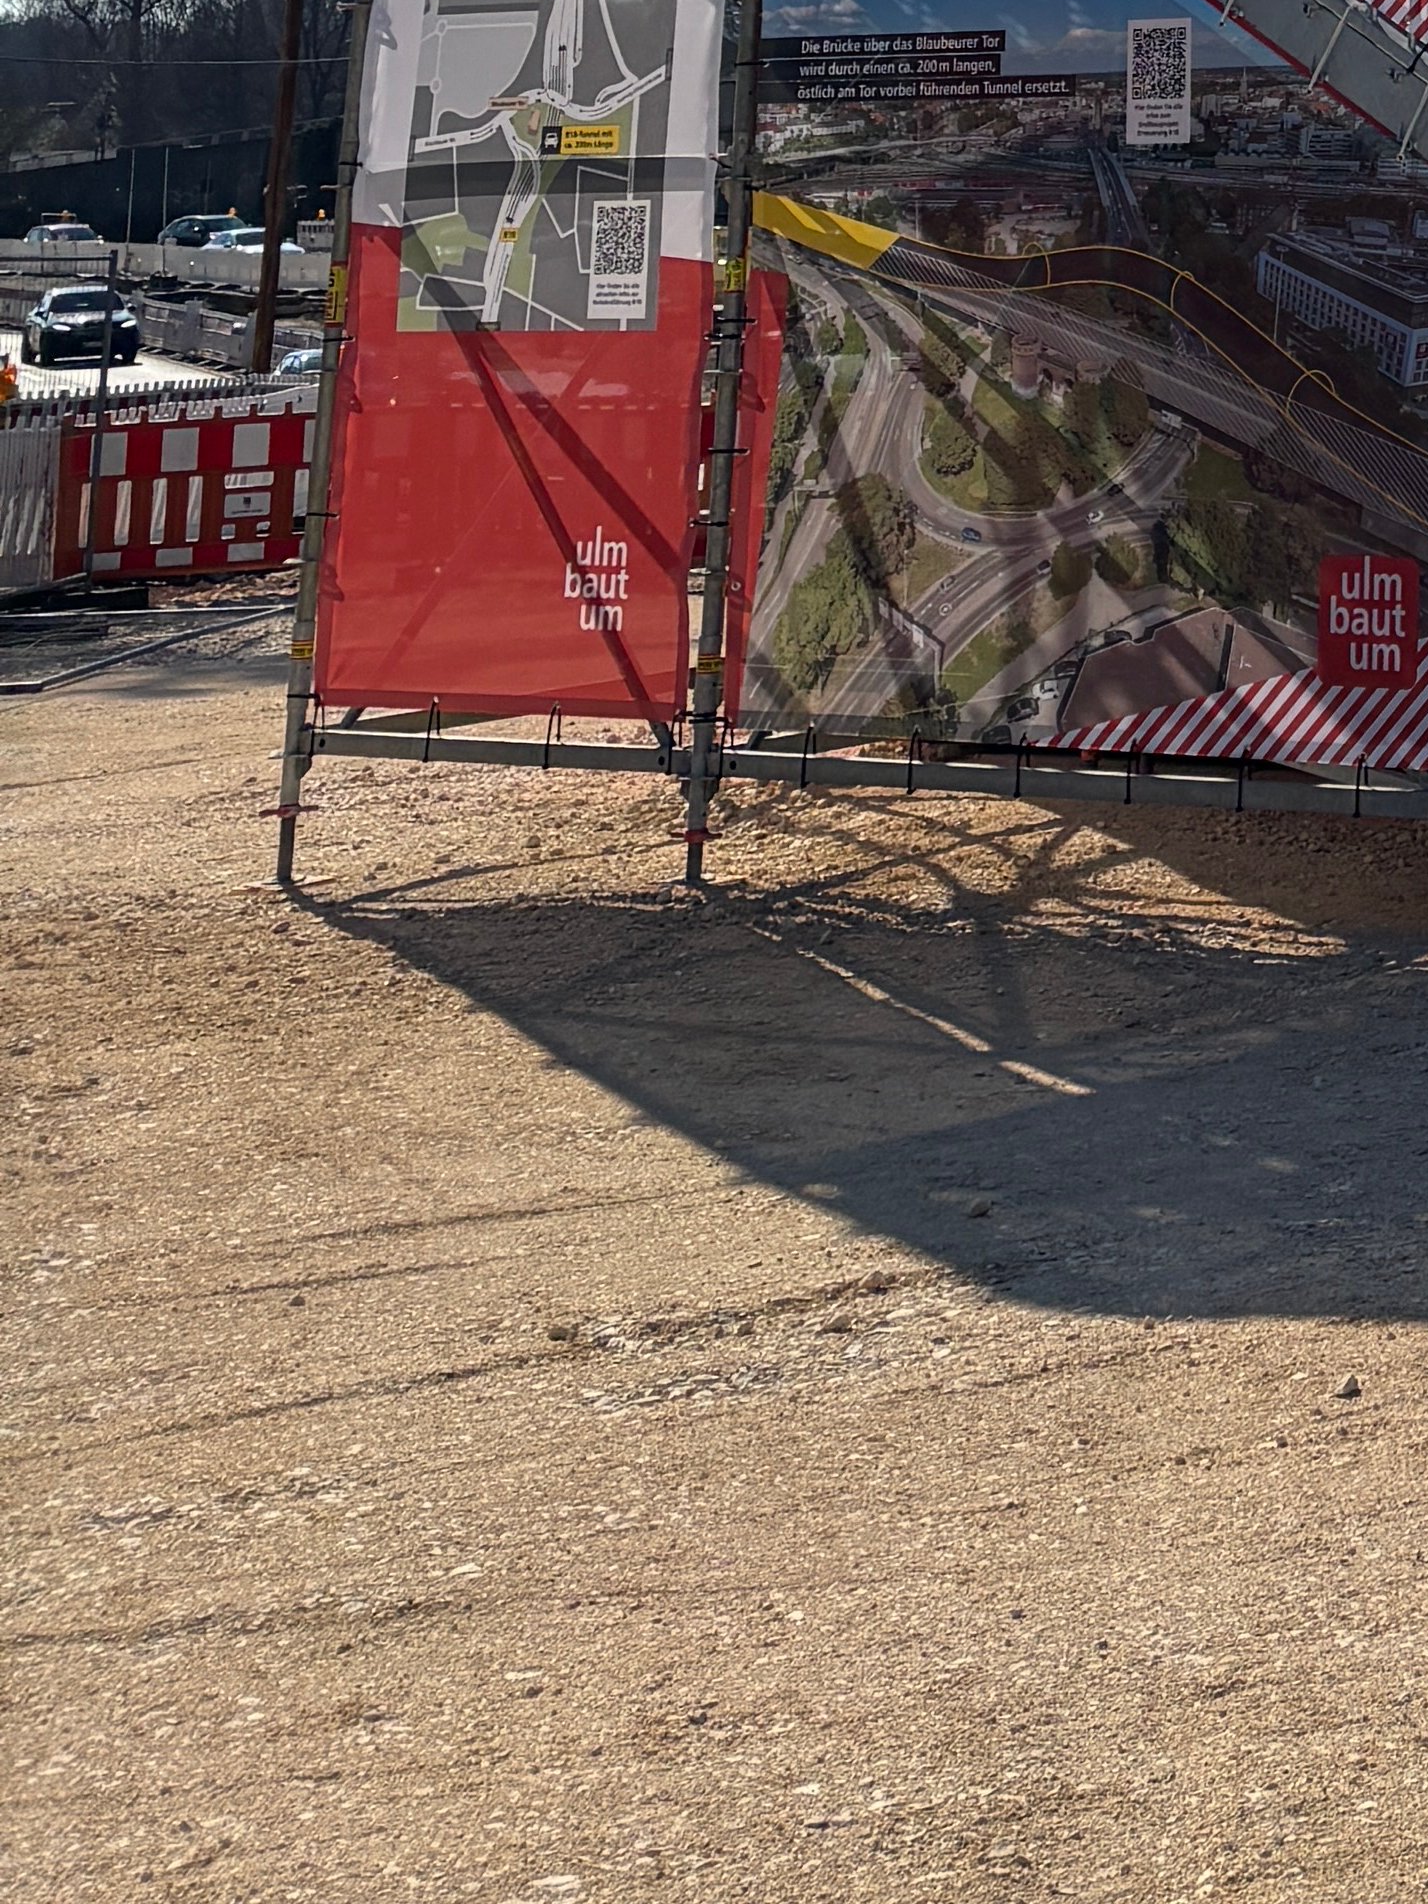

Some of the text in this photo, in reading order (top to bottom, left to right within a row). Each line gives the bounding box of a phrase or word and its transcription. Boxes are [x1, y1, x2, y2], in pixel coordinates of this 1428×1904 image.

[801, 35, 1000, 54] Die Brücke über das Blaubeurer Tor
[799, 61, 826, 77] wird
[828, 60, 861, 76] durch
[863, 60, 895, 75] einen
[898, 62, 914, 75] ca.
[953, 58, 996, 75] langen,
[797, 79, 1070, 100] östlich am Tor vorbei führenden Tunnel ersetzt.
[576, 525, 628, 568] ulm
[563, 562, 630, 600] baut
[1341, 555, 1403, 602] ulm
[579, 603, 624, 632] um
[1329, 595, 1407, 638] baut
[1349, 642, 1402, 673] um
